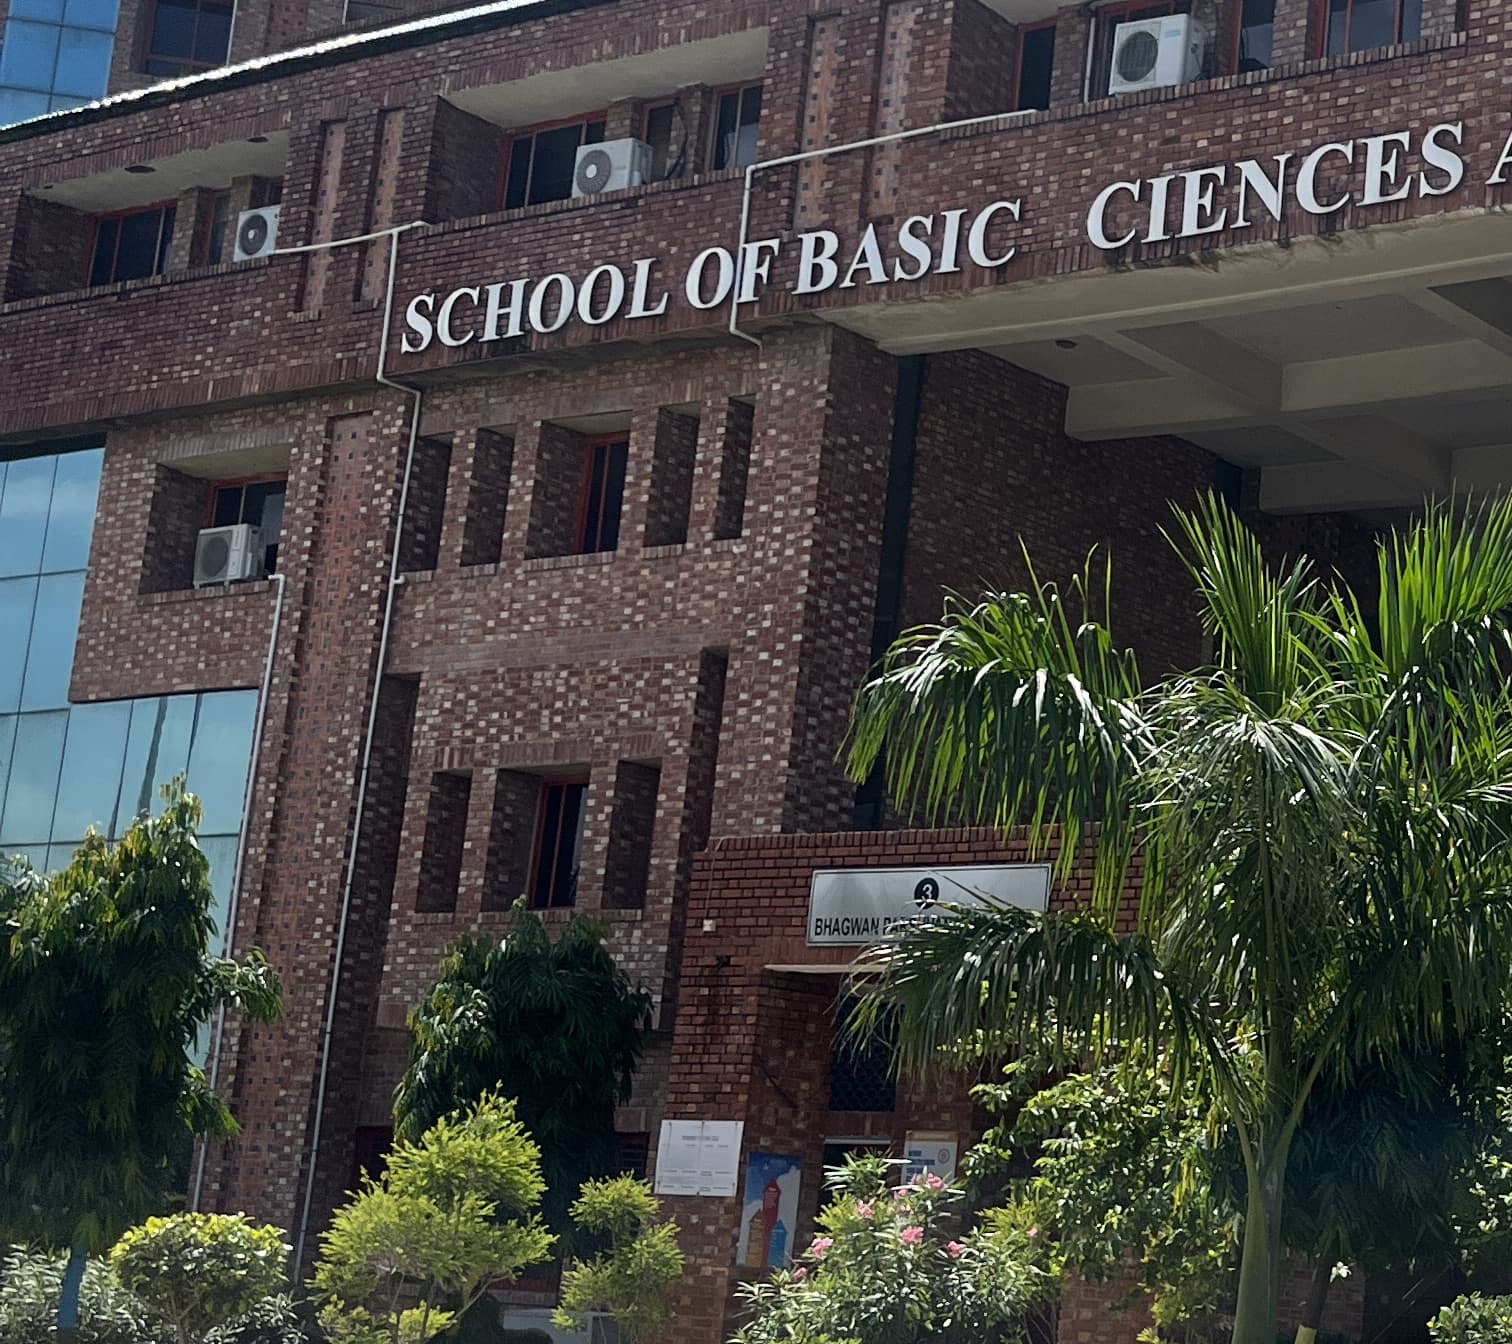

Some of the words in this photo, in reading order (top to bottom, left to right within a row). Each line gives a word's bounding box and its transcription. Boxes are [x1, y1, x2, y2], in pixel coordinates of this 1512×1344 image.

[400, 257, 669, 354] SCHOOL
[684, 238, 781, 309] OF
[791, 198, 1021, 296] BASIC
[1086, 121, 1464, 250] CIENCES
[922, 883, 933, 901] 3
[814, 917, 880, 936] BHAGWAN
